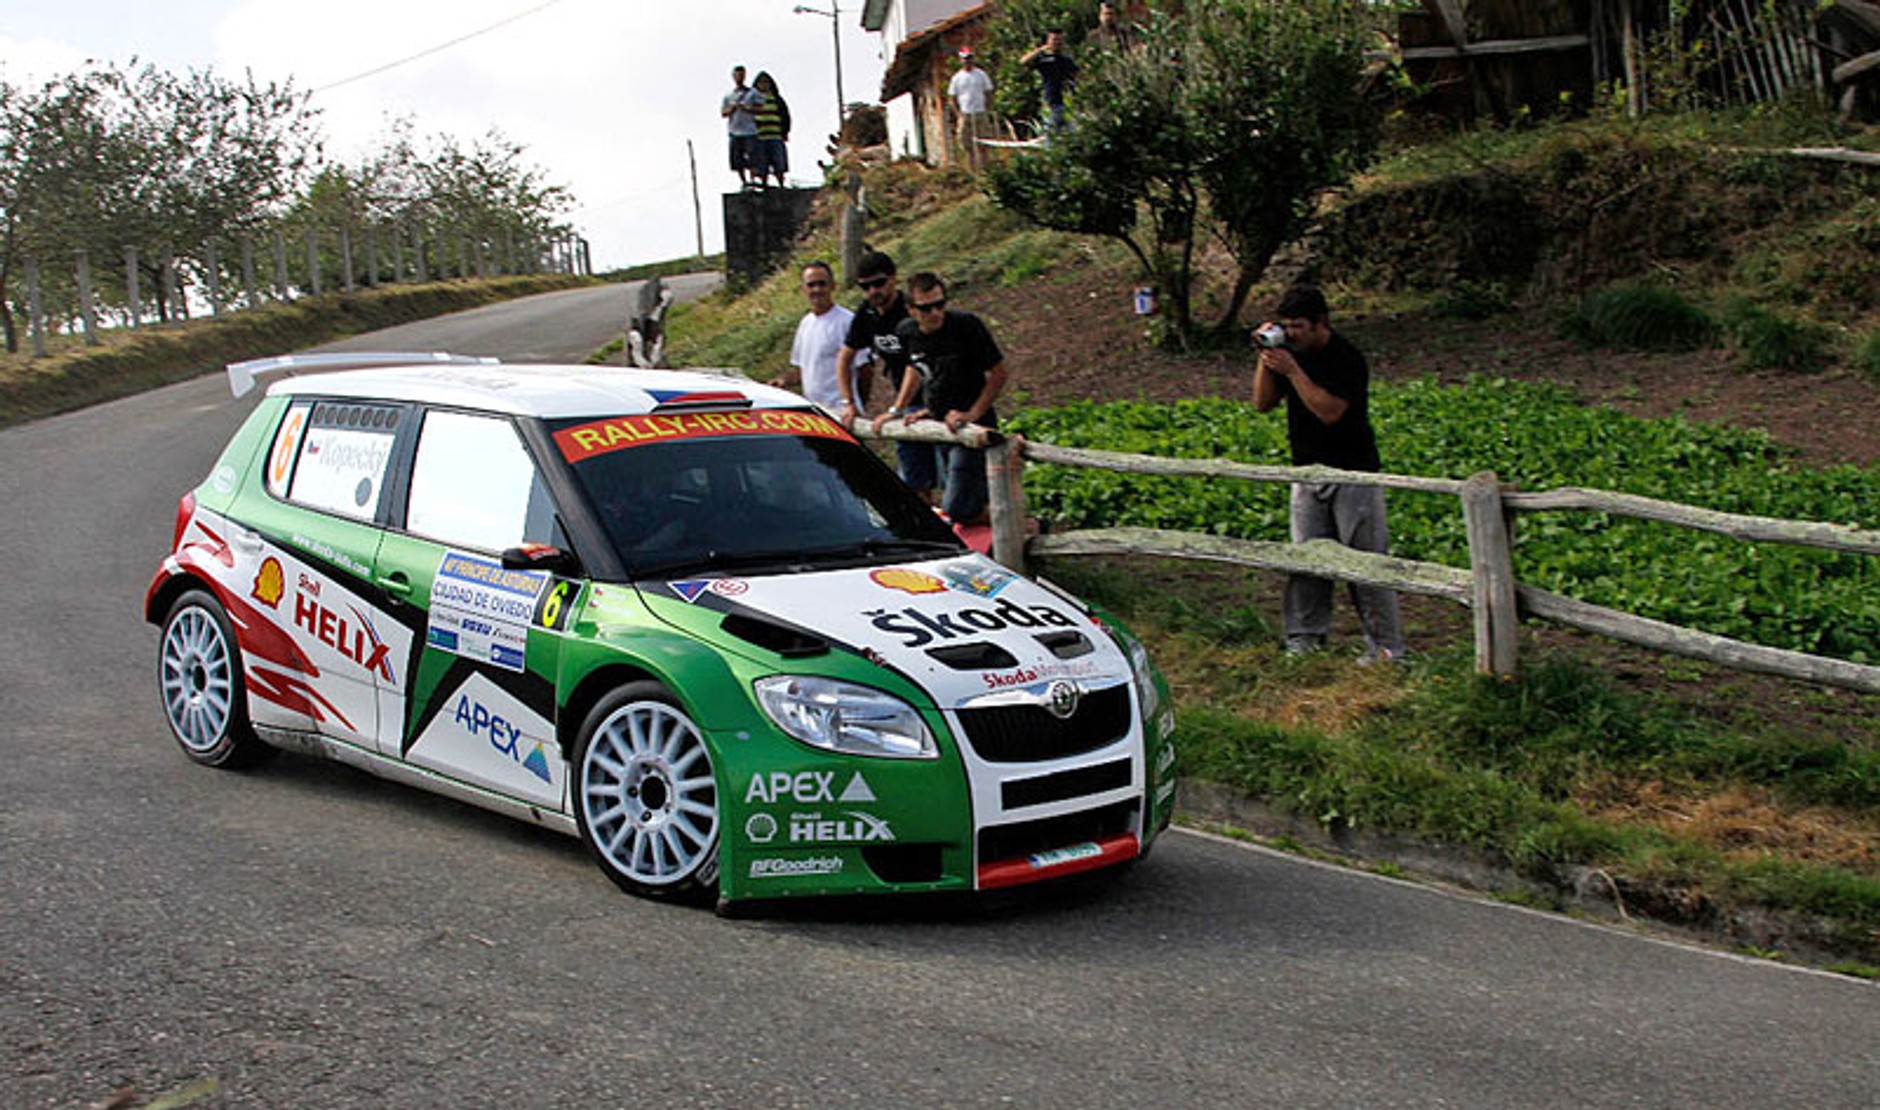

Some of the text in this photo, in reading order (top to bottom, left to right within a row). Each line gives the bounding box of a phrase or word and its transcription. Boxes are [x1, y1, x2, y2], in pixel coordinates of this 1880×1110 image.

[275, 412, 302, 482] 6
[571, 411, 839, 451] RALLY-IRC.COM
[432, 581, 473, 604] CIUDAD
[491, 597, 532, 619] OVIEDO
[542, 581, 568, 628] 6
[860, 597, 1079, 648] Škoda
[294, 591, 395, 685] HELIX
[455, 694, 521, 763] APEX
[744, 770, 836, 803] APEX
[789, 810, 897, 842] HELIX
